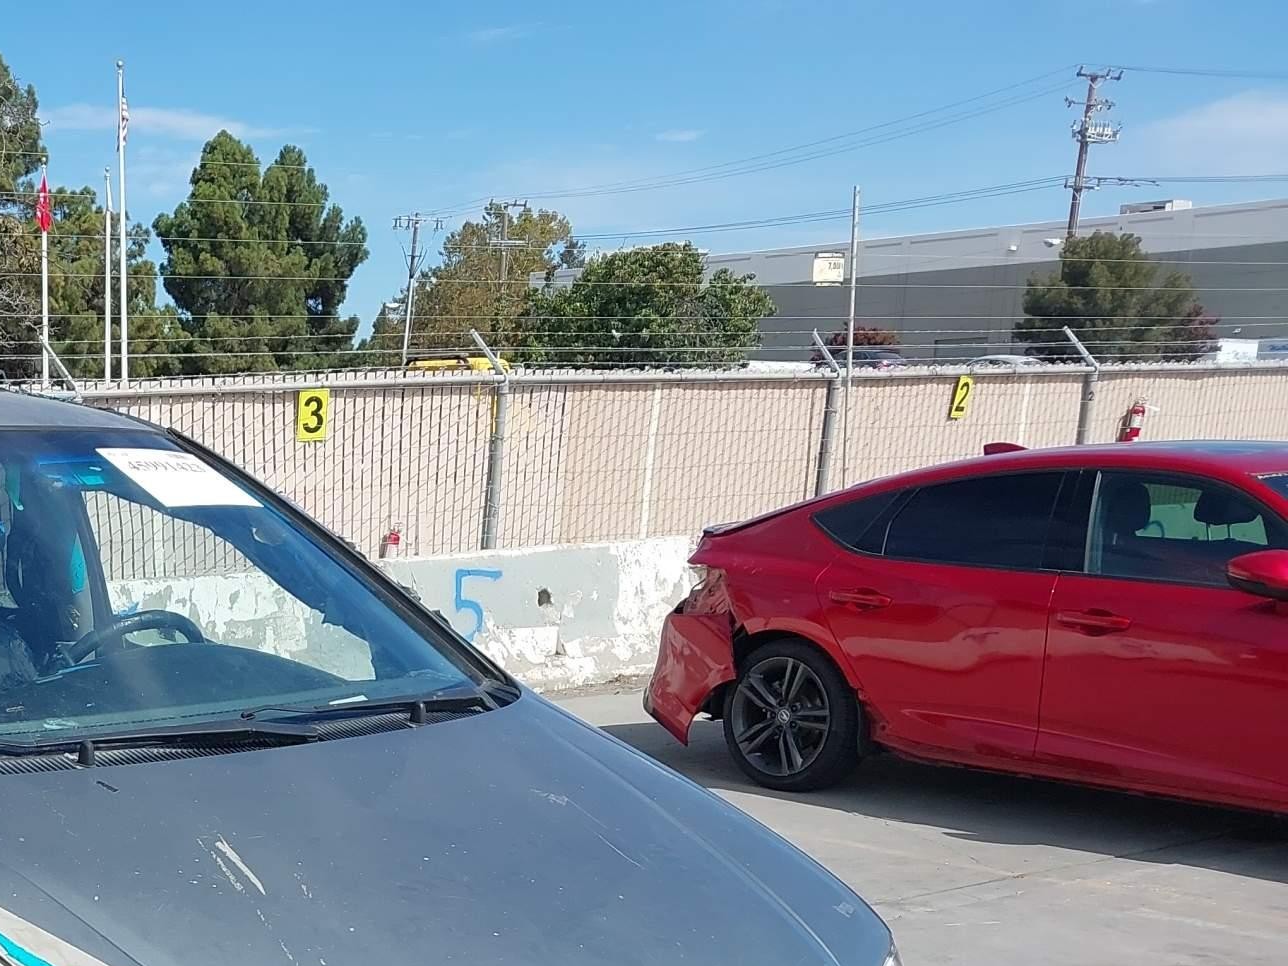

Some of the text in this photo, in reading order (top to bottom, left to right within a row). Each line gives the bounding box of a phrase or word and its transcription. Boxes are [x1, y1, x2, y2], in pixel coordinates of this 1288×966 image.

[302, 395, 324, 434] 3
[954, 381, 970, 412] 2
[455, 569, 503, 642] 5
